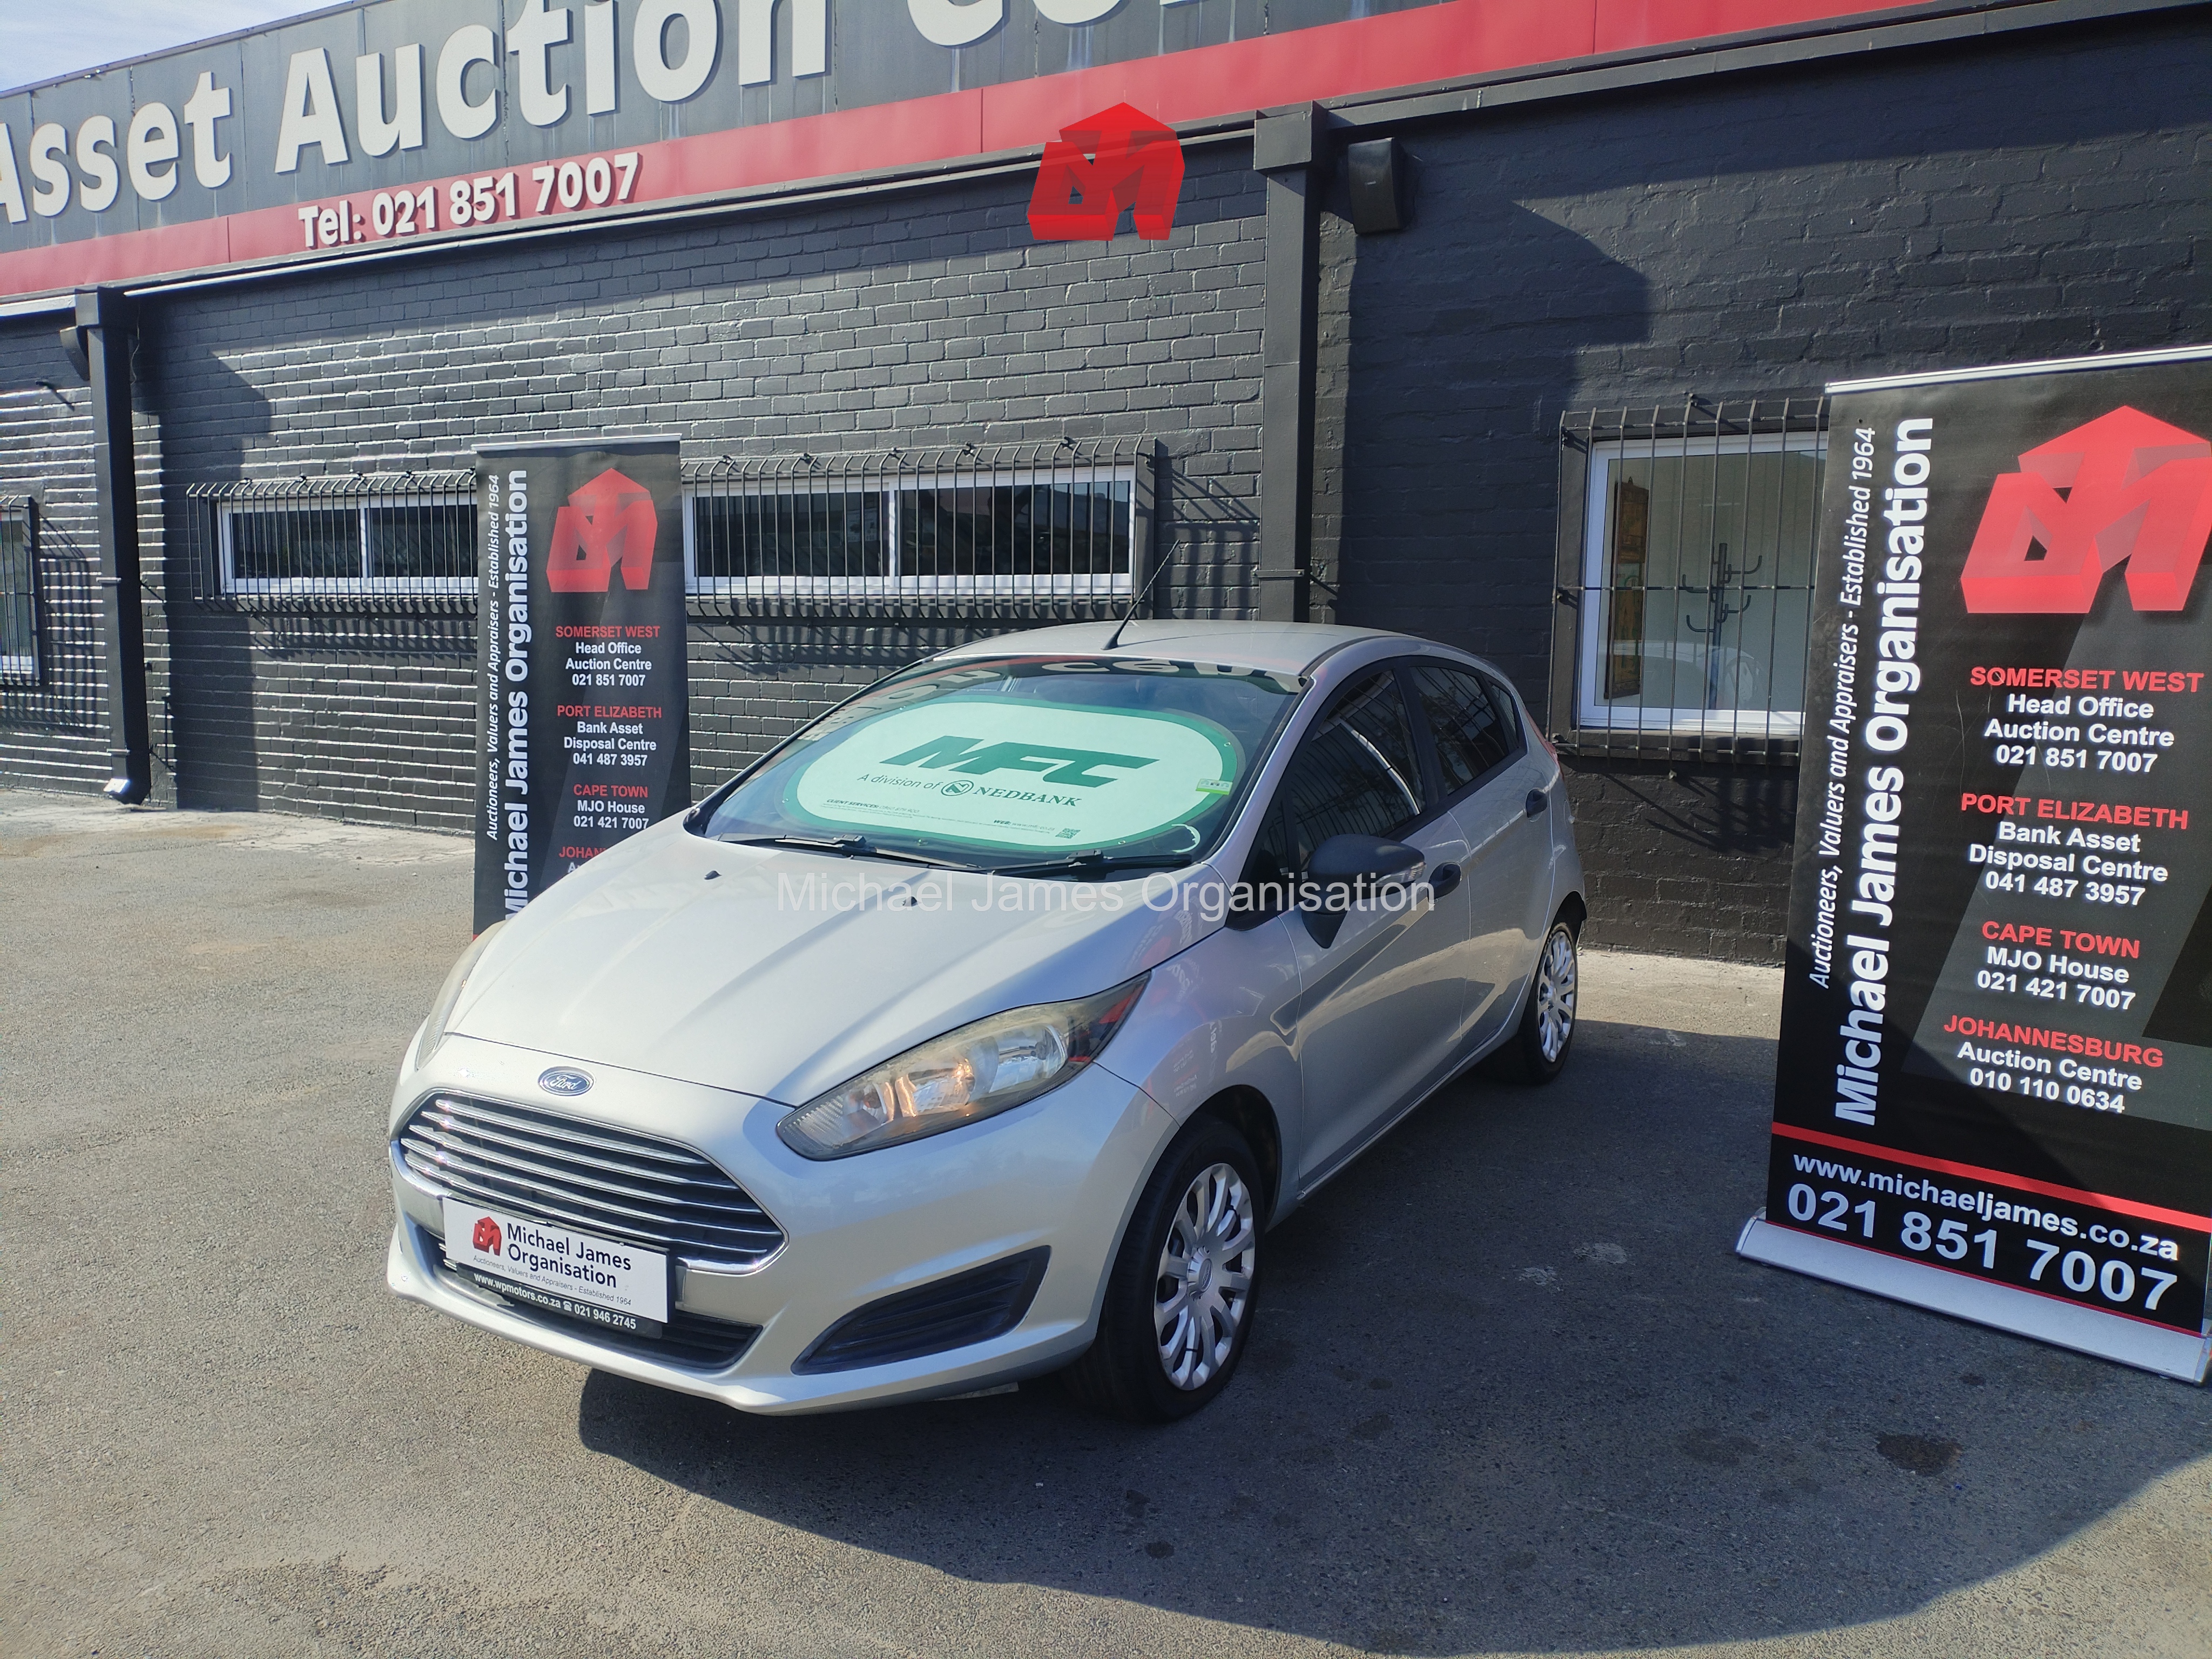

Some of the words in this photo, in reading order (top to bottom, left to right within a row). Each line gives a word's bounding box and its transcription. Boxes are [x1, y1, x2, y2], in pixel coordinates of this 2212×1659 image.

[274, 0, 827, 173] Auction
[298, 205, 363, 248] Tel:
[373, 186, 435, 237] 021
[449, 170, 517, 225] 851
[534, 153, 640, 213] 7007
[1853, 428, 1875, 480] 1964
[488, 475, 499, 508] 1964
[488, 511, 499, 589] Established
[1840, 485, 1871, 606] Established
[505, 470, 532, 682] Organisation
[1865, 417, 1933, 752] Organisation
[488, 600, 501, 671] Appraisers
[556, 626, 621, 638] SOMERSET
[625, 626, 660, 637] WEST
[576, 642, 605, 653] Head
[608, 642, 641, 653] Office
[565, 658, 611, 670] Auction
[614, 658, 652, 670] Centre
[572, 674, 591, 685] 021
[596, 674, 615, 685] 851
[619, 674, 645, 685] 7007
[1833, 623, 1859, 734] Appraisers
[1970, 667, 2115, 690] SOMERSET
[2123, 671, 2204, 692] WEST
[488, 673, 498, 700] and
[2008, 694, 2071, 715] Head
[2078, 696, 2154, 718] Office
[487, 704, 498, 752] Valuers
[557, 706, 591, 717] PORT
[594, 706, 662, 718] ELIZABETH
[577, 721, 607, 733] Bank
[610, 723, 643, 734] Asset
[505, 691, 528, 795] James
[564, 737, 615, 751] Disposal
[618, 738, 657, 750] Centre
[1984, 719, 2079, 741] Auction
[2088, 723, 2174, 747] Centre
[573, 753, 593, 764] 041
[597, 753, 617, 765] 487
[621, 754, 648, 766] 3957
[879, 734, 1161, 788] MFC
[1830, 738, 1850, 778] and
[1996, 745, 2035, 764] 021
[2045, 747, 2086, 767] 851
[2098, 750, 2157, 772] 7007
[487, 758, 500, 840] Auctioneers,
[574, 784, 608, 797] CAPE
[611, 785, 648, 798] TOWN
[577, 800, 604, 812] MJO
[608, 801, 645, 814] House
[871, 775, 921, 788] division
[925, 781, 943, 790] of
[973, 786, 1082, 806] NEDBANK
[574, 815, 593, 827] 021
[598, 817, 617, 828] 421
[622, 817, 649, 829] 7007
[1819, 784, 1844, 856] Valuers
[1961, 793, 2031, 816] PORT
[2038, 800, 2188, 829] ELIZABETH
[1851, 766, 1903, 926] James
[1998, 822, 2061, 845] Bank
[2066, 827, 2141, 852] Asset
[1969, 844, 2075, 872] Disposal
[2082, 854, 2168, 882] Centre
[1985, 872, 2024, 892] 041
[2033, 878, 2078, 898] 487
[2085, 882, 2145, 905] 3957
[1810, 865, 1840, 989] Auctioneers,
[1982, 920, 2052, 946] CAPE
[2060, 929, 2140, 959] TOWN
[1987, 946, 2042, 970] MJO
[2049, 954, 2129, 983] House
[1977, 970, 2017, 992] 021
[2025, 975, 2068, 1000] 421
[2077, 983, 2136, 1010] 7007
[1836, 936, 1890, 1126] Michael
[1944, 1015, 2163, 1067] JOHANNESBURG
[550, 1075, 582, 1090] Ford
[1958, 1042, 2052, 1074] Auction
[2059, 1057, 2142, 1090] Centre
[1970, 1068, 2011, 1090] 010
[2019, 1076, 2060, 1100] 110
[2067, 1085, 2125, 1114] 0634
[1793, 1155, 2178, 1261] www.michaeljames.co.za
[507, 1223, 570, 1256] Michael
[576, 1242, 631, 1270] James
[508, 1244, 616, 1287] Organisation
[1789, 1184, 1876, 1238] 021
[1901, 1211, 1997, 1269] 851
[2026, 1238, 2177, 1310] 7007
[473, 1255, 506, 1272] Auctioneers,
[508, 1266, 528, 1280] Valuers
[530, 1273, 540, 1281] and
[542, 1276, 573, 1291] Appraisers
[579, 1286, 614, 1302] Established
[616, 1296, 632, 1306] 1964
[474, 1272, 561, 1309] www.wpmotors.co.za
[574, 1304, 590, 1317] 021
[594, 1309, 610, 1323] 946
[612, 1313, 636, 1330] 2745
